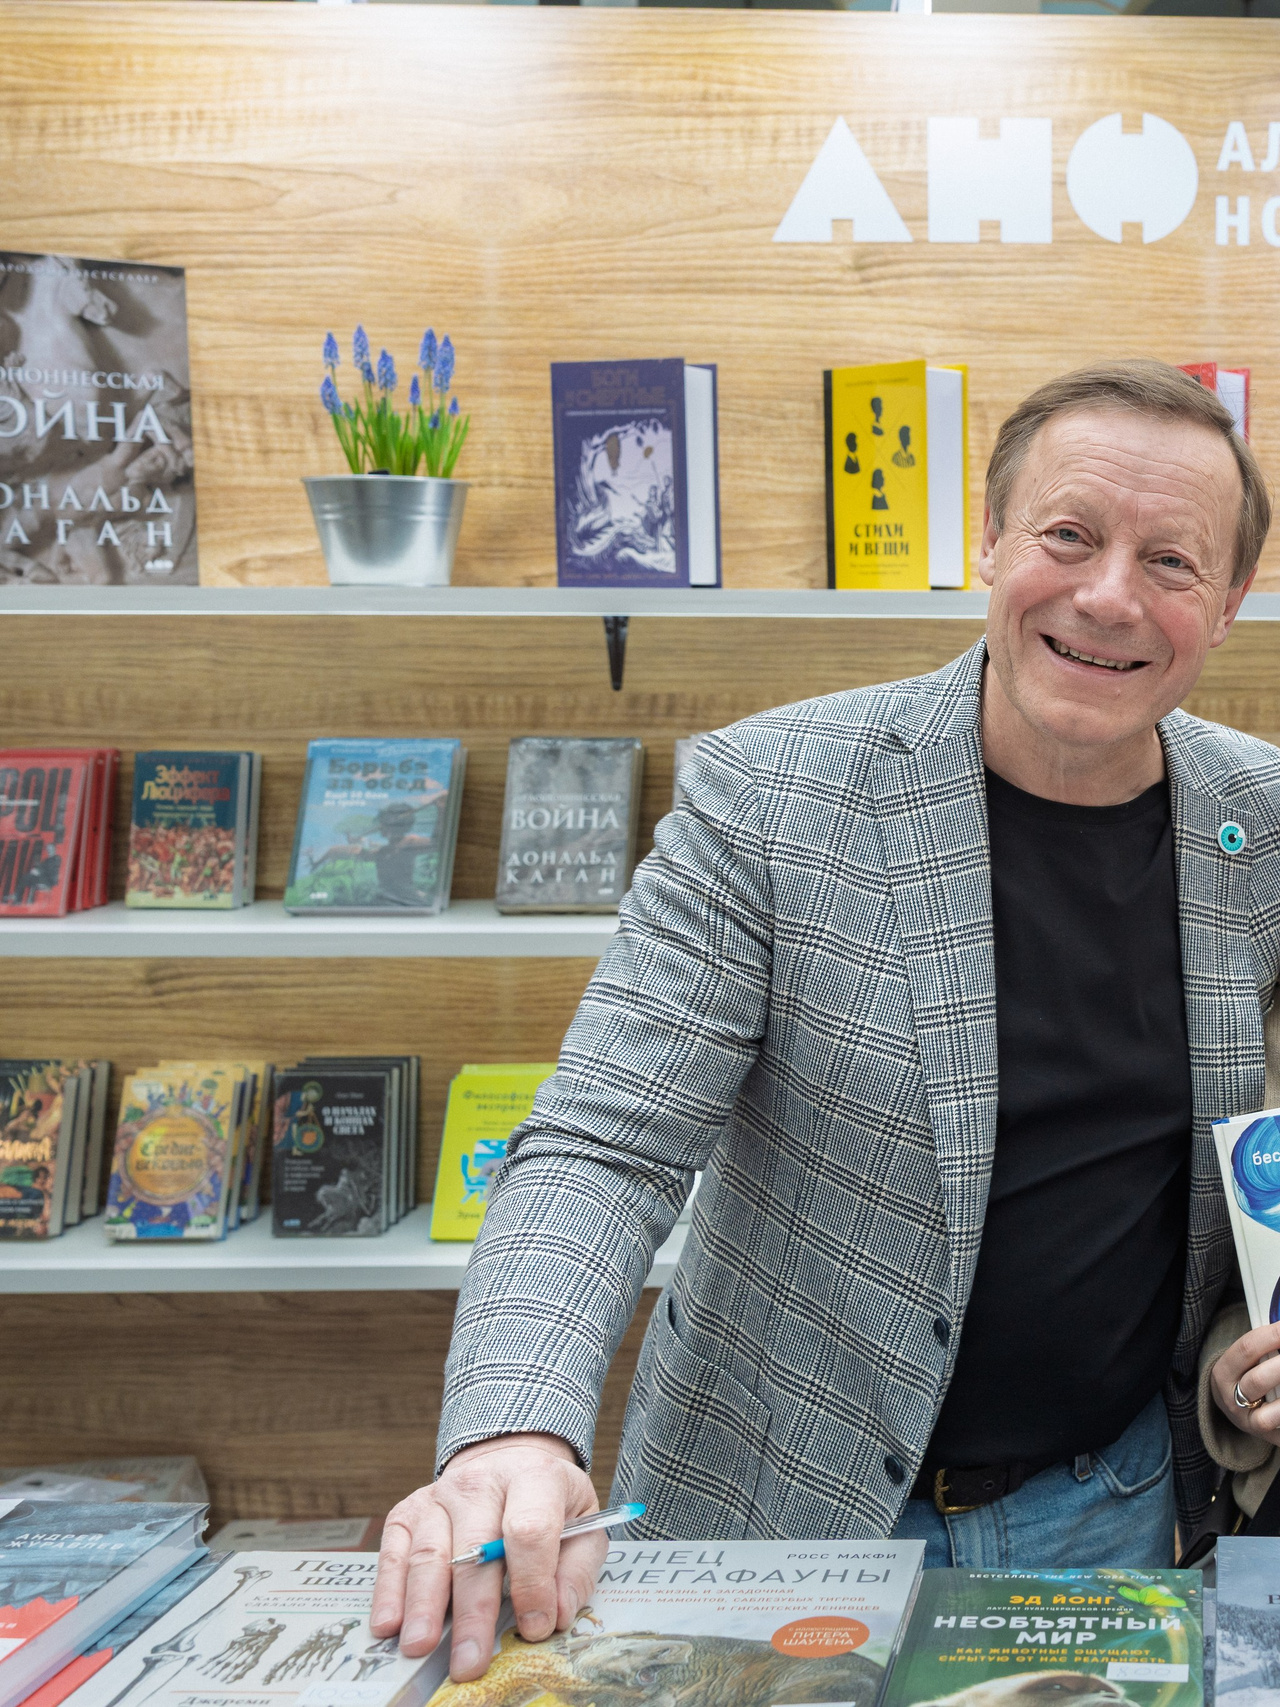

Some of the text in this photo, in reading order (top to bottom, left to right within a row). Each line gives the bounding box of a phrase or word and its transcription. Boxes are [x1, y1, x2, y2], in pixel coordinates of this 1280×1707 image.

[0, 366, 164, 391] ПОННЕССКАЯ
[0, 390, 172, 445] ОЙНА
[0, 480, 173, 514] ОНАЛЬД
[6, 519, 173, 547] АГАН
[854, 524, 903, 538] СТИХИ
[849, 542, 909, 556] И ВЕЩИ
[154, 764, 219, 786] Эффект
[328, 757, 428, 778] Борьба
[366, 777, 427, 792] обед
[141, 781, 230, 804] Люцифера
[511, 803, 619, 830] ВОЙНА
[506, 850, 617, 867] ДОНАЛЬД
[506, 868, 616, 884] КАГАН
[463, 1089, 535, 1101] Философск
[16, 1533, 104, 1541] АНДРЕЙ
[603, 1550, 725, 1567] ОНЕЦ
[290, 1560, 379, 1576] Перв
[301, 1576, 375, 1586] шаг
[597, 1569, 892, 1584] МЕГАФАУНЫ
[1009, 1594, 1116, 1606] ЭД ЙОНГ
[933, 1615, 1181, 1631] НЕОБЪЯТНЫЙ
[784, 1638, 855, 1646] ШАУТЕНА
[793, 1631, 850, 1639] ПИТЕРА
[1015, 1631, 1097, 1645] МИР
[939, 1655, 1009, 1663] СКРЫТУЮ
[184, 1697, 273, 1707] Джереми
